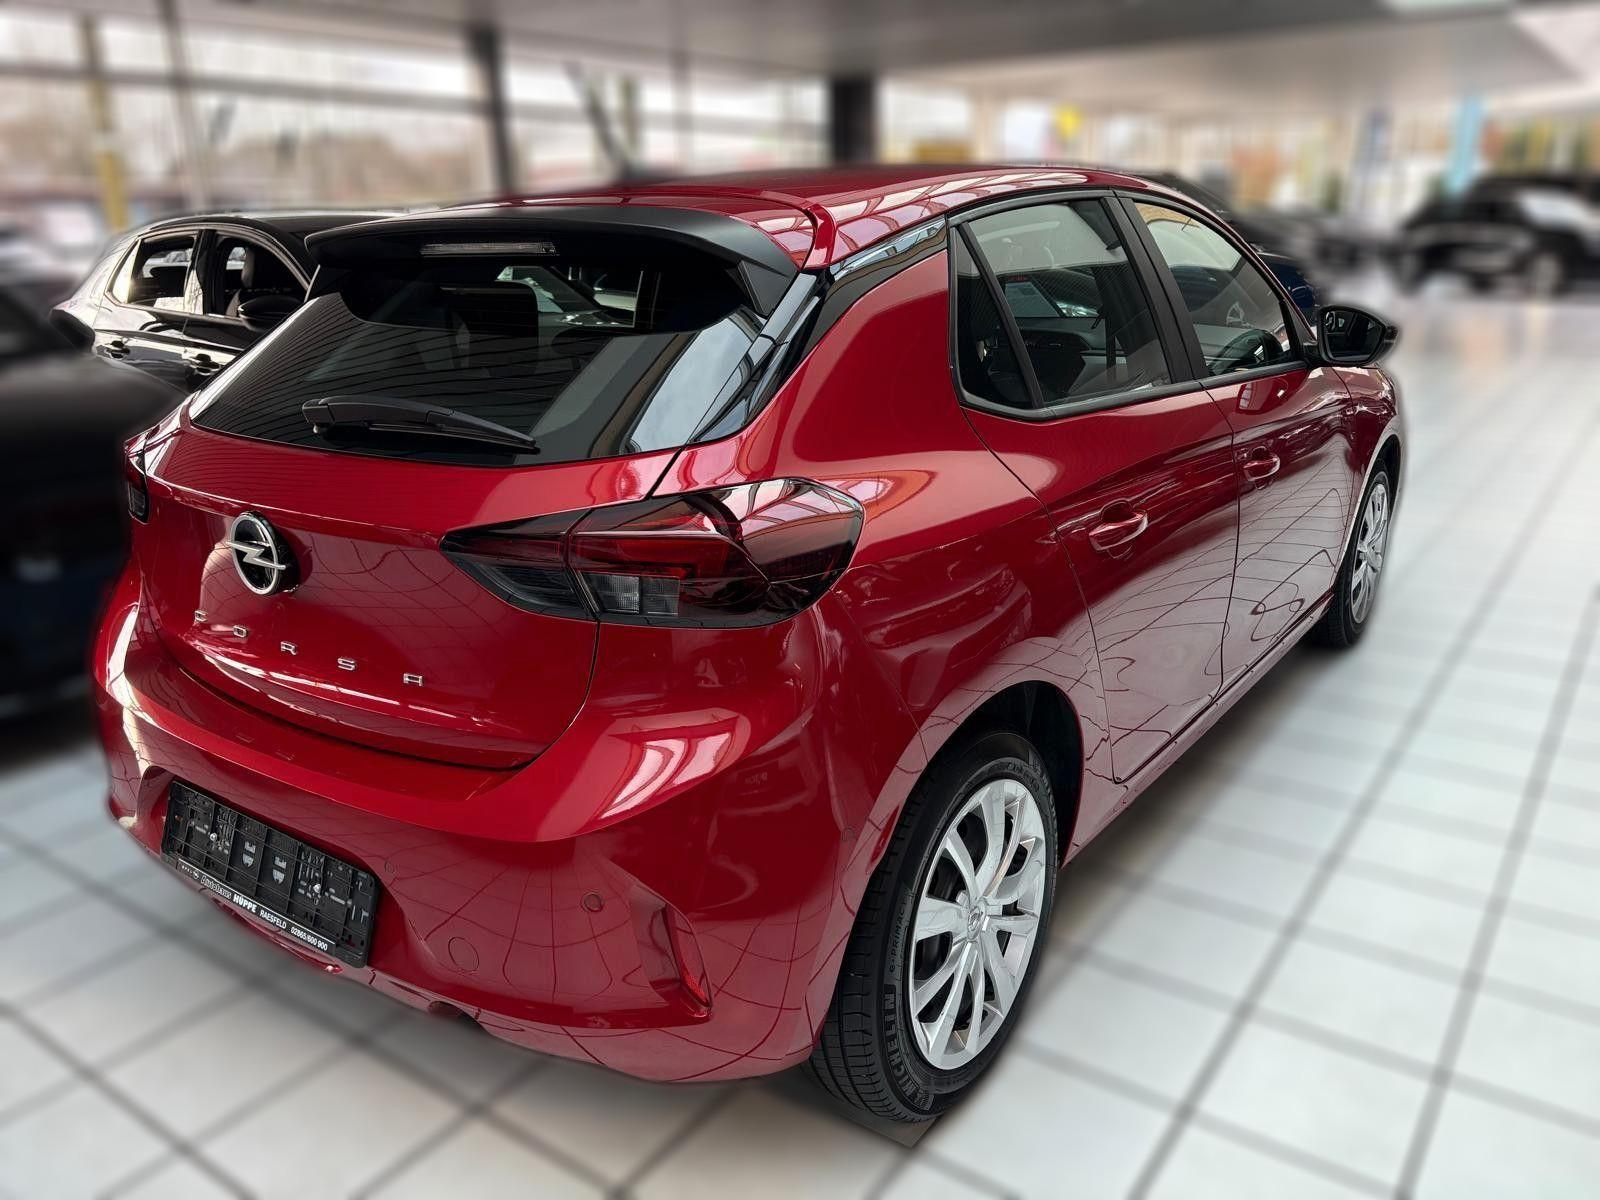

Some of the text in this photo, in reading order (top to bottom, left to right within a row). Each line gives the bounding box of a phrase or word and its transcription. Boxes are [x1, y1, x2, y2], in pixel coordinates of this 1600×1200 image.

[194, 609, 425, 688] CORSA
[233, 892, 258, 914] HÜPPE
[259, 909, 287, 929] RAESFELD
[883, 993, 918, 1097] MICHELIN
